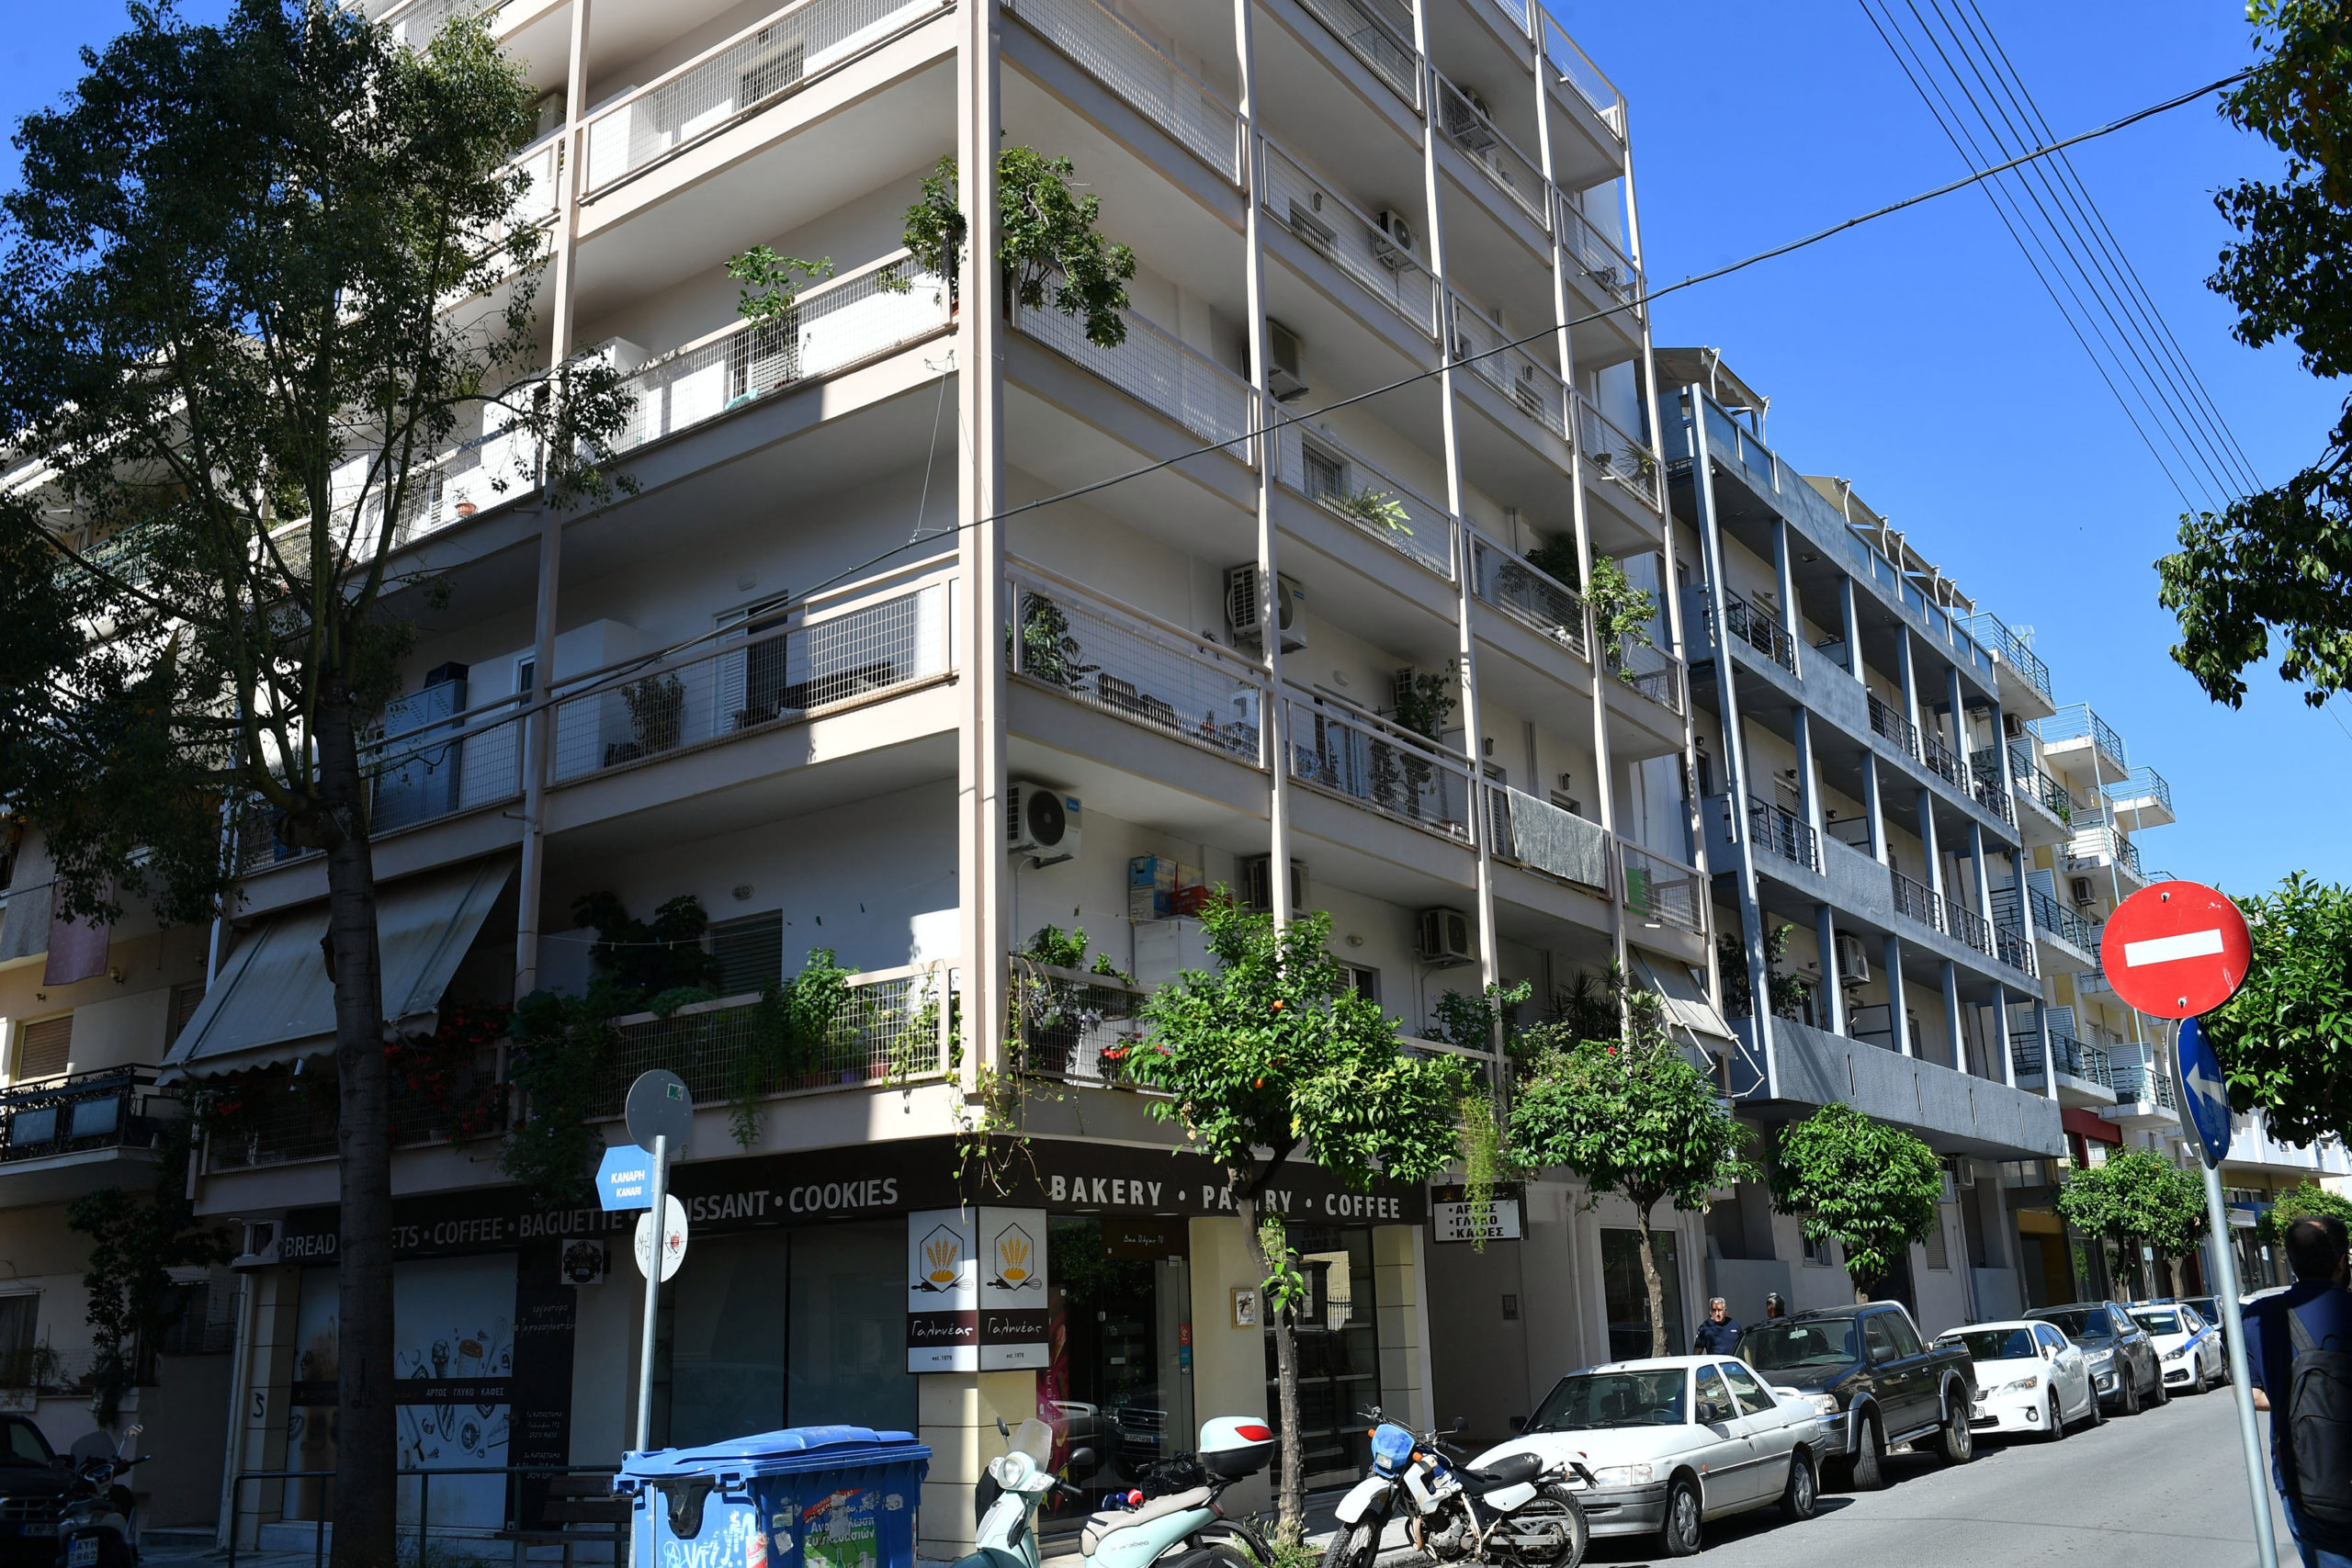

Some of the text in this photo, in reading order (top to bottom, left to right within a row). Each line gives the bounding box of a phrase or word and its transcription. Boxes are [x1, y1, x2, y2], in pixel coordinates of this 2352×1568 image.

[611, 1169, 646, 1183] ΚΑΝΑΡΗ
[616, 1186, 642, 1198] KANARI
[1051, 1175, 1400, 1219] BAKERY PARY COFFEE
[1456, 1203, 1497, 1214] ΑΡΟΣ
[285, 1233, 336, 1258] BREAD
[434, 1217, 503, 1245] COFFEE
[519, 1207, 624, 1238] BAGUETTE
[685, 1190, 770, 1223] ISSANT
[789, 1178, 899, 1213] COOKIES
[911, 1320, 974, 1338] Γαληνέας
[988, 1317, 1043, 1337] Γαληνέας
[426, 1388, 448, 1397] ΑΡΤΟΣ
[453, 1388, 475, 1397] ΓΛΥΚΟ
[481, 1387, 505, 1396] ΚΑΦΕΣ
